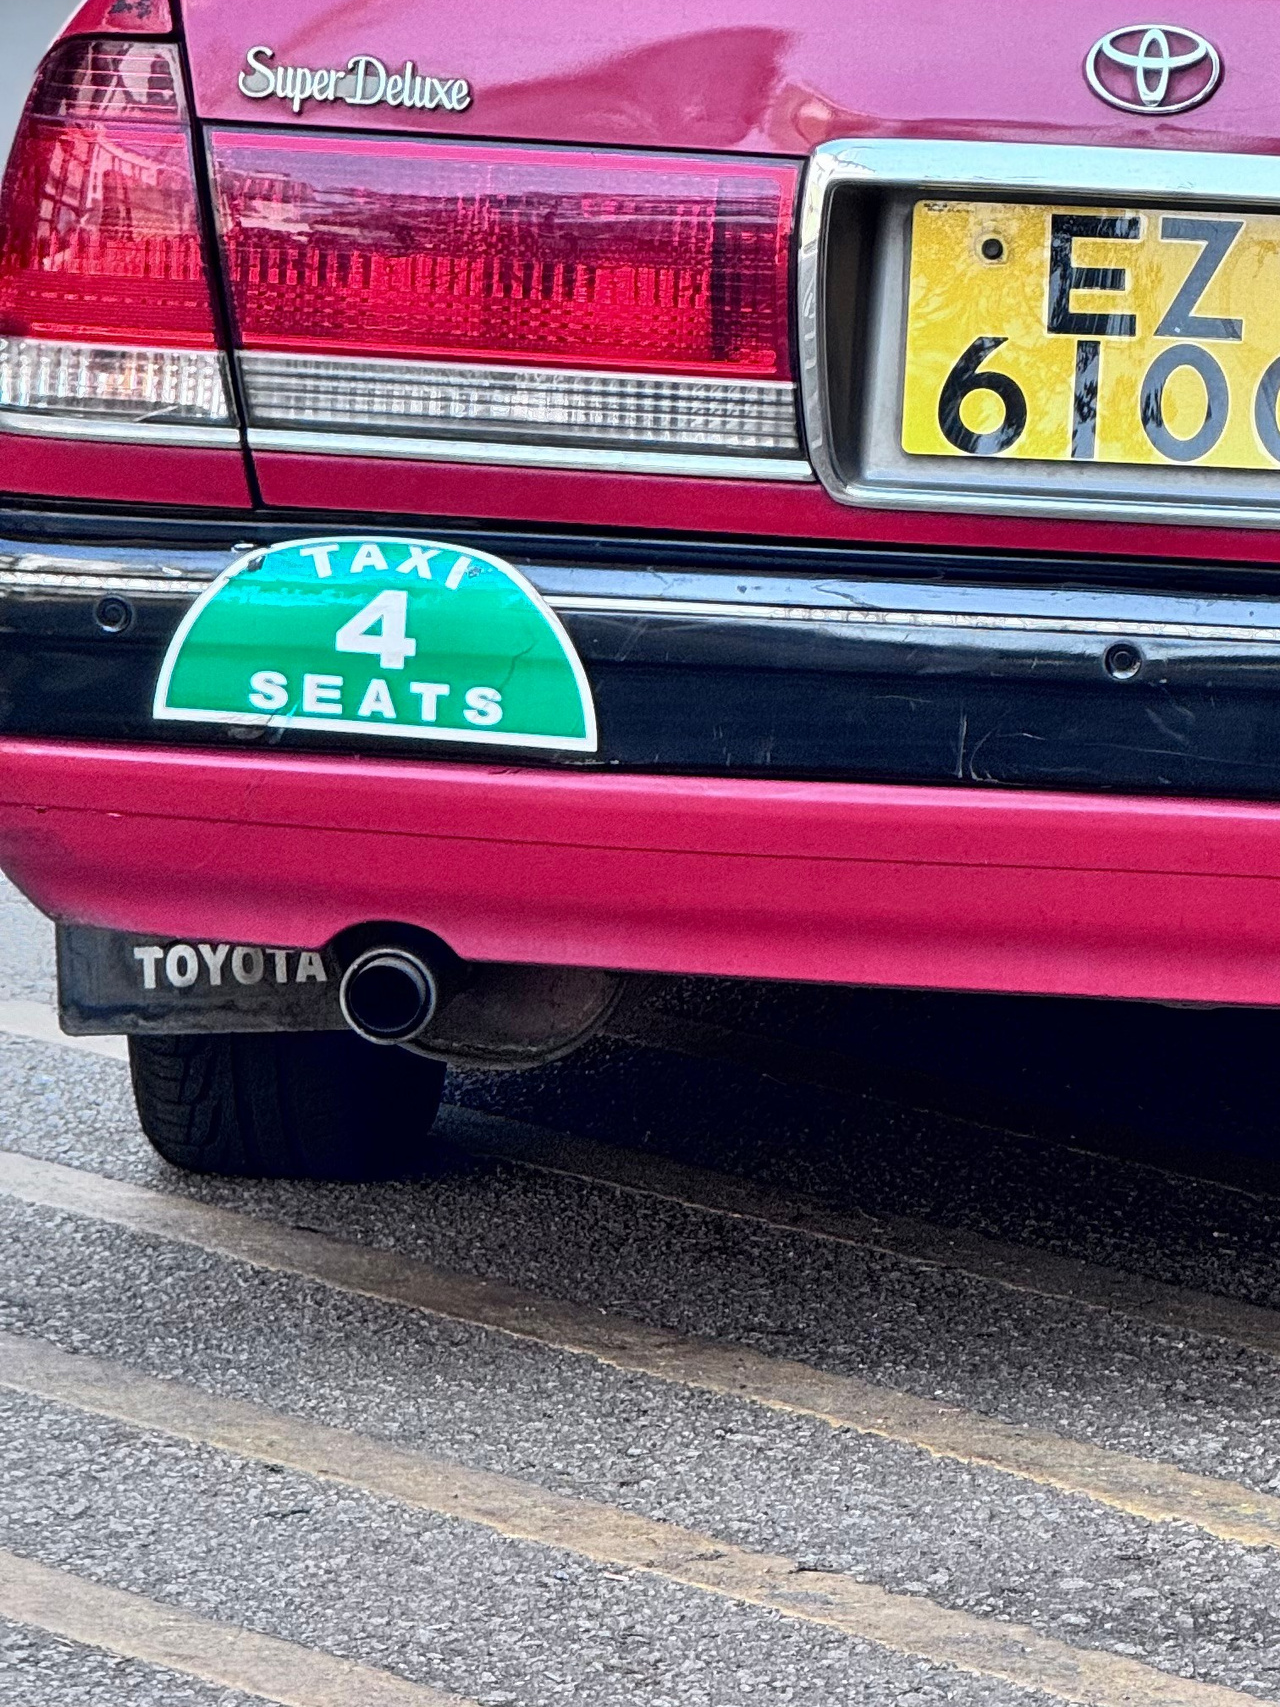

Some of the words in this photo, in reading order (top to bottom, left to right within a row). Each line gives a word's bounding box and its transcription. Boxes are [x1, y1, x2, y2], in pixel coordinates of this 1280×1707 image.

[1047, 214, 1245, 342] EZ
[300, 544, 471, 590] TAXI
[335, 590, 416, 670] 4
[248, 671, 503, 726] SEATS
[133, 944, 328, 989] TOYOTA
